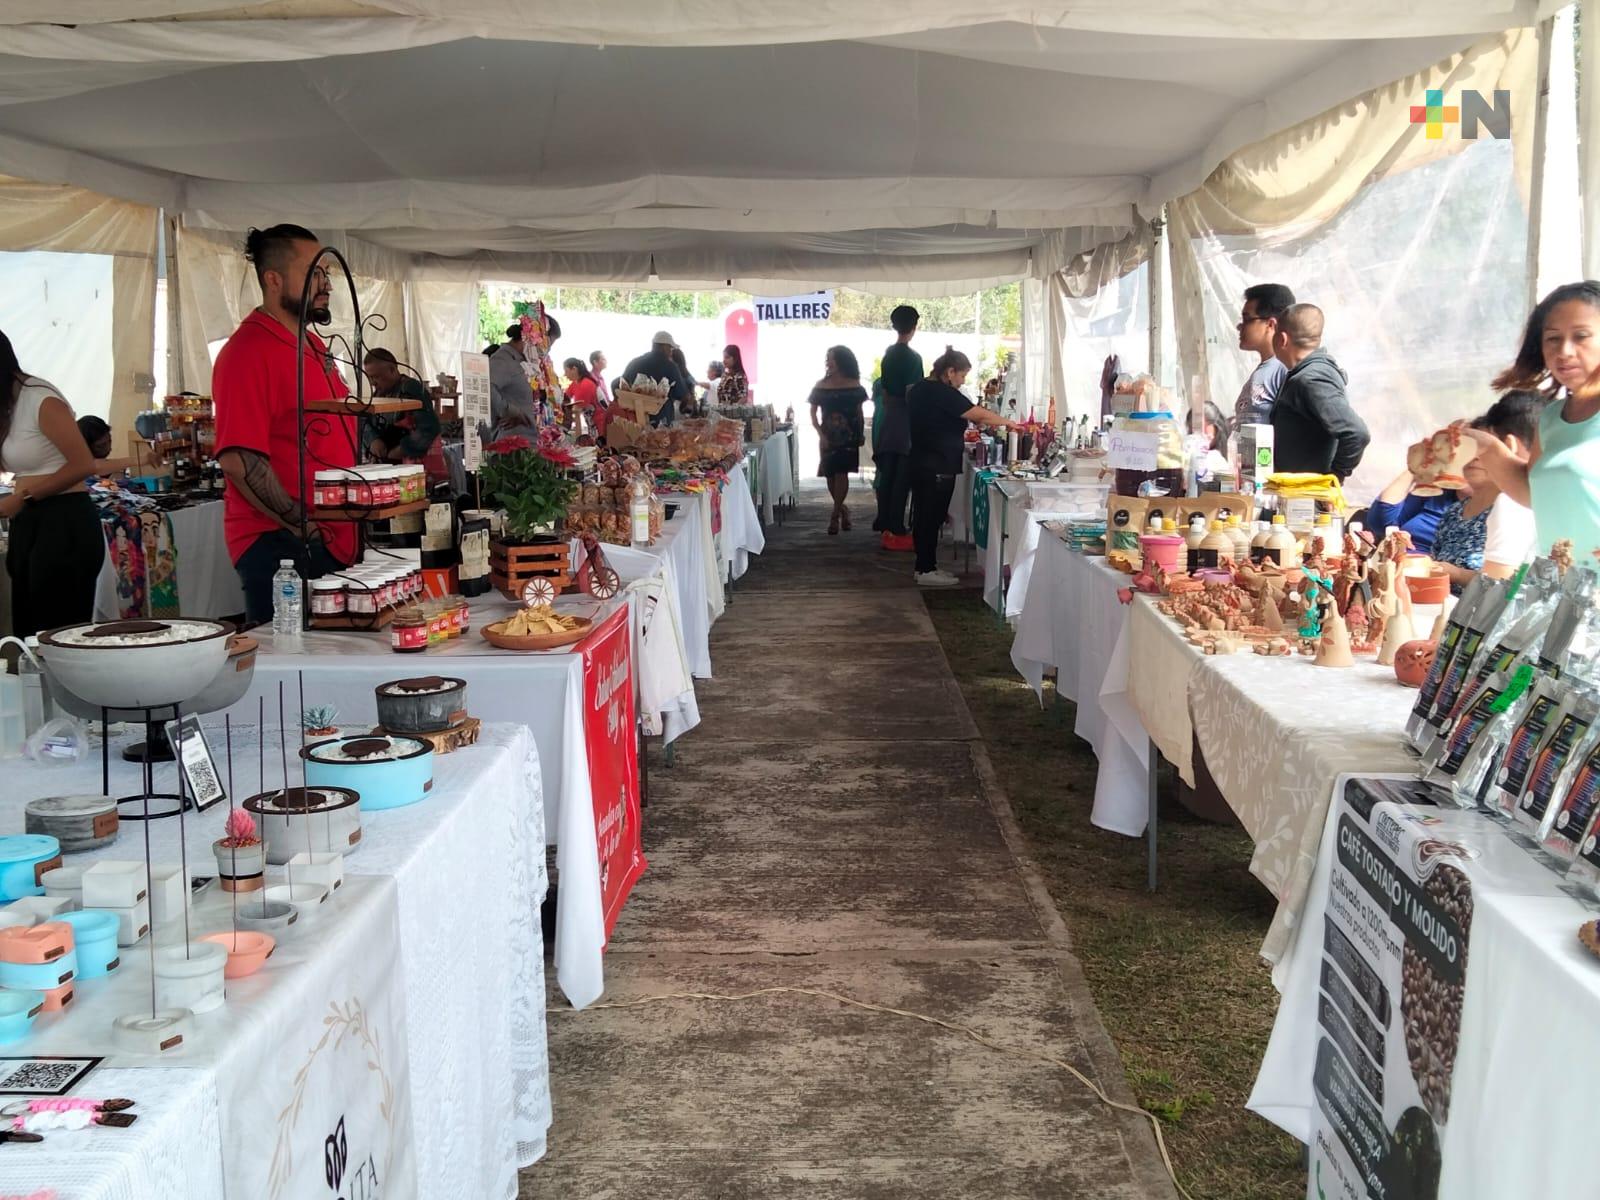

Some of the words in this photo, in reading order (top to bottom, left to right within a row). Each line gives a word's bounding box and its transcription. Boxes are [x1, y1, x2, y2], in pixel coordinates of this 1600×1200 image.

[756, 301, 831, 321] TALLERES
[1332, 868, 1361, 914] Cultivado
[1341, 825, 1362, 864] CAFÉ
[1362, 848, 1402, 906] TOSTADO
[1402, 890, 1411, 915] Y
[1411, 900, 1457, 964] MOLIDO
